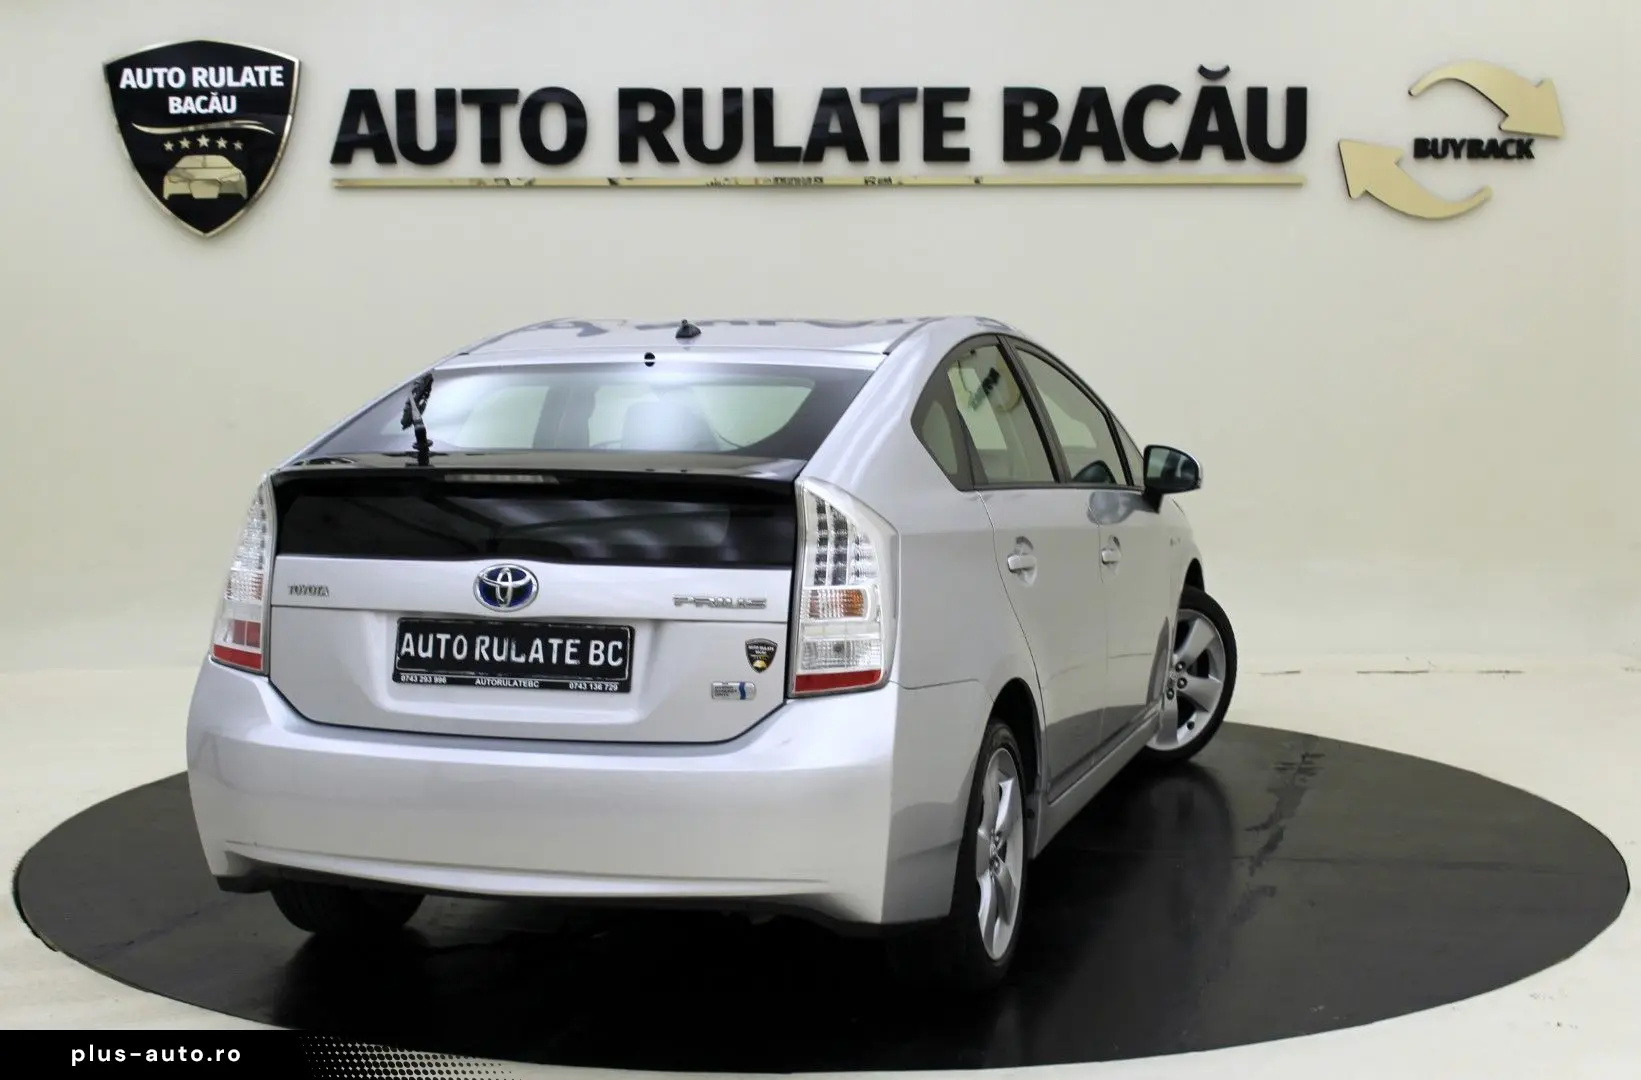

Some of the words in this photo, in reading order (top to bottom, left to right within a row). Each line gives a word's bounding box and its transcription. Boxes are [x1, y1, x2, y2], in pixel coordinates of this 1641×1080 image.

[119, 67, 186, 89] AUTO
[192, 66, 284, 88] RULATE
[168, 92, 237, 114] BACĂU
[330, 86, 587, 165] AUTO
[618, 87, 970, 164] RULATE
[1003, 65, 1307, 163] BACĂU
[1413, 137, 1535, 160] BUYBACK
[288, 584, 330, 597] TOYOTA
[400, 632, 468, 661] AUTO
[474, 635, 581, 666] RULATE
[588, 640, 623, 667] BC
[475, 677, 540, 688] AUTORULATEBC
[569, 681, 588, 691] 0743
